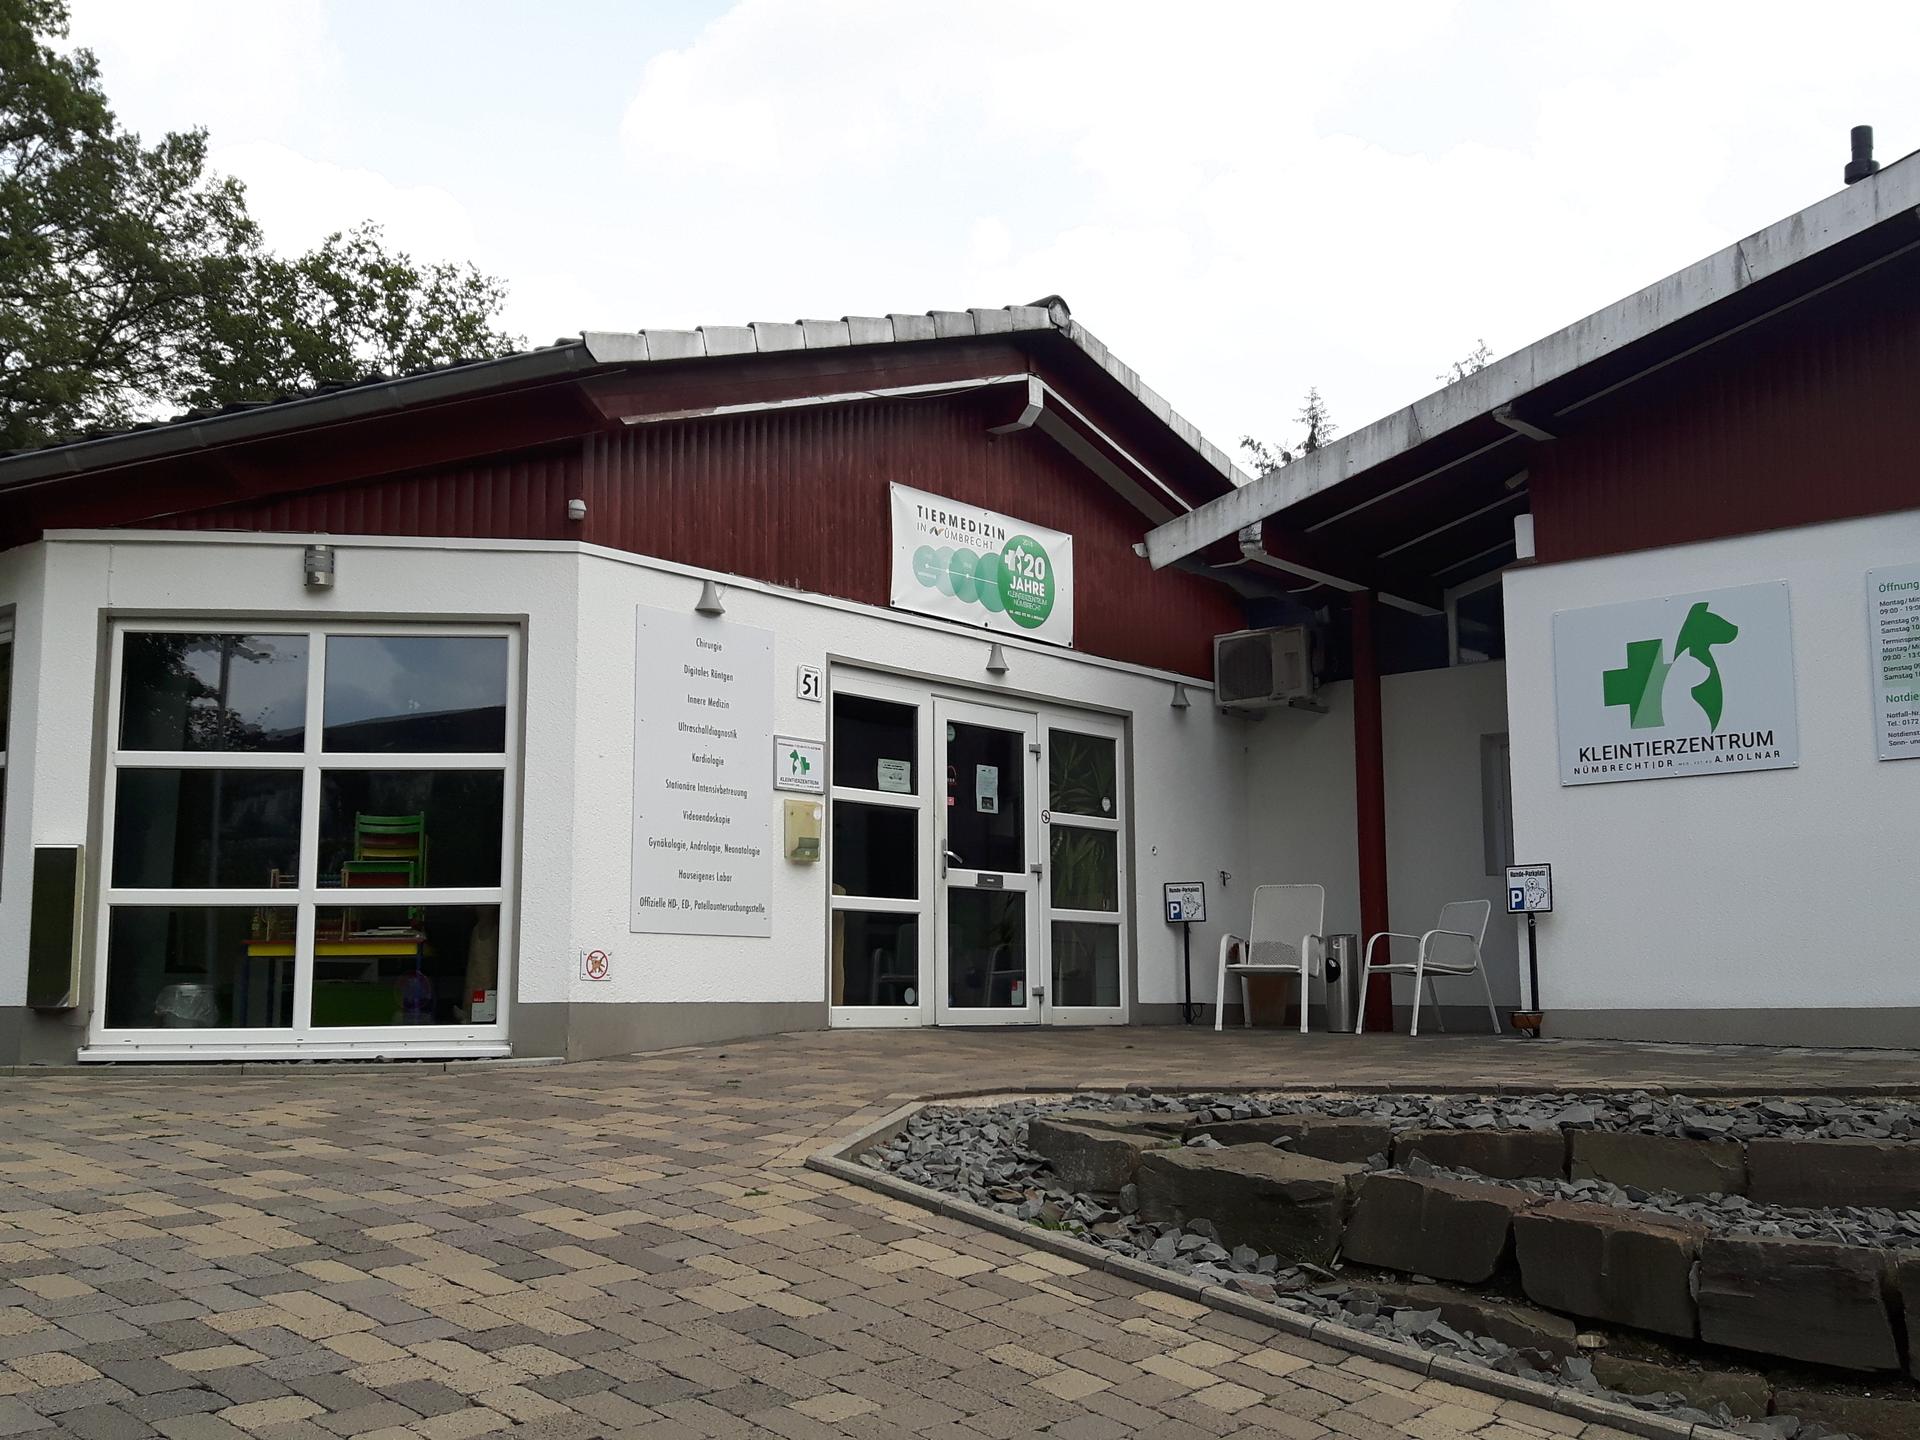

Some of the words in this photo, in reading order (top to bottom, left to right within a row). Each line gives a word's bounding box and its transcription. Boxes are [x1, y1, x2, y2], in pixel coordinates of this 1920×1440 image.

[917, 505, 1005, 541] TIERMEDIZIN
[917, 522, 927, 532] IN
[1023, 553, 1046, 580] 20
[1009, 575, 1045, 597] JAHRE
[1879, 599, 1904, 607] Montag
[1880, 618, 1910, 626] Dienstag
[1881, 626, 1910, 634] Samstag
[695, 637, 722, 652] Chirurgie
[683, 664, 709, 677] Digitales
[710, 668, 734, 682] Röntgen
[1883, 665, 1913, 673] Dienstag
[1884, 673, 1913, 681] Samstag
[802, 673, 818, 698] 51
[687, 694, 706, 706] Innere
[707, 696, 730, 709] Medizin
[678, 721, 738, 739] Ultraschalldiagnostik
[1579, 730, 1774, 762] KLEINTIERZENTRUM
[691, 752, 724, 767] Kardiologie
[665, 778, 696, 791] Stationäre
[697, 782, 748, 799] Intensivbetreuung
[682, 810, 731, 826] Videoendoskopie
[648, 837, 688, 851] Gynäkologie,
[689, 840, 723, 854] Andrologie,
[724, 843, 760, 858] Neonatologie
[678, 869, 715, 882] Hauseigenes
[716, 871, 733, 882] Labor
[639, 896, 666, 908] Offizielle
[694, 899, 765, 915] Patellauntersuchungsstelle
[1511, 890, 1523, 909] P
[1170, 903, 1180, 919] P
